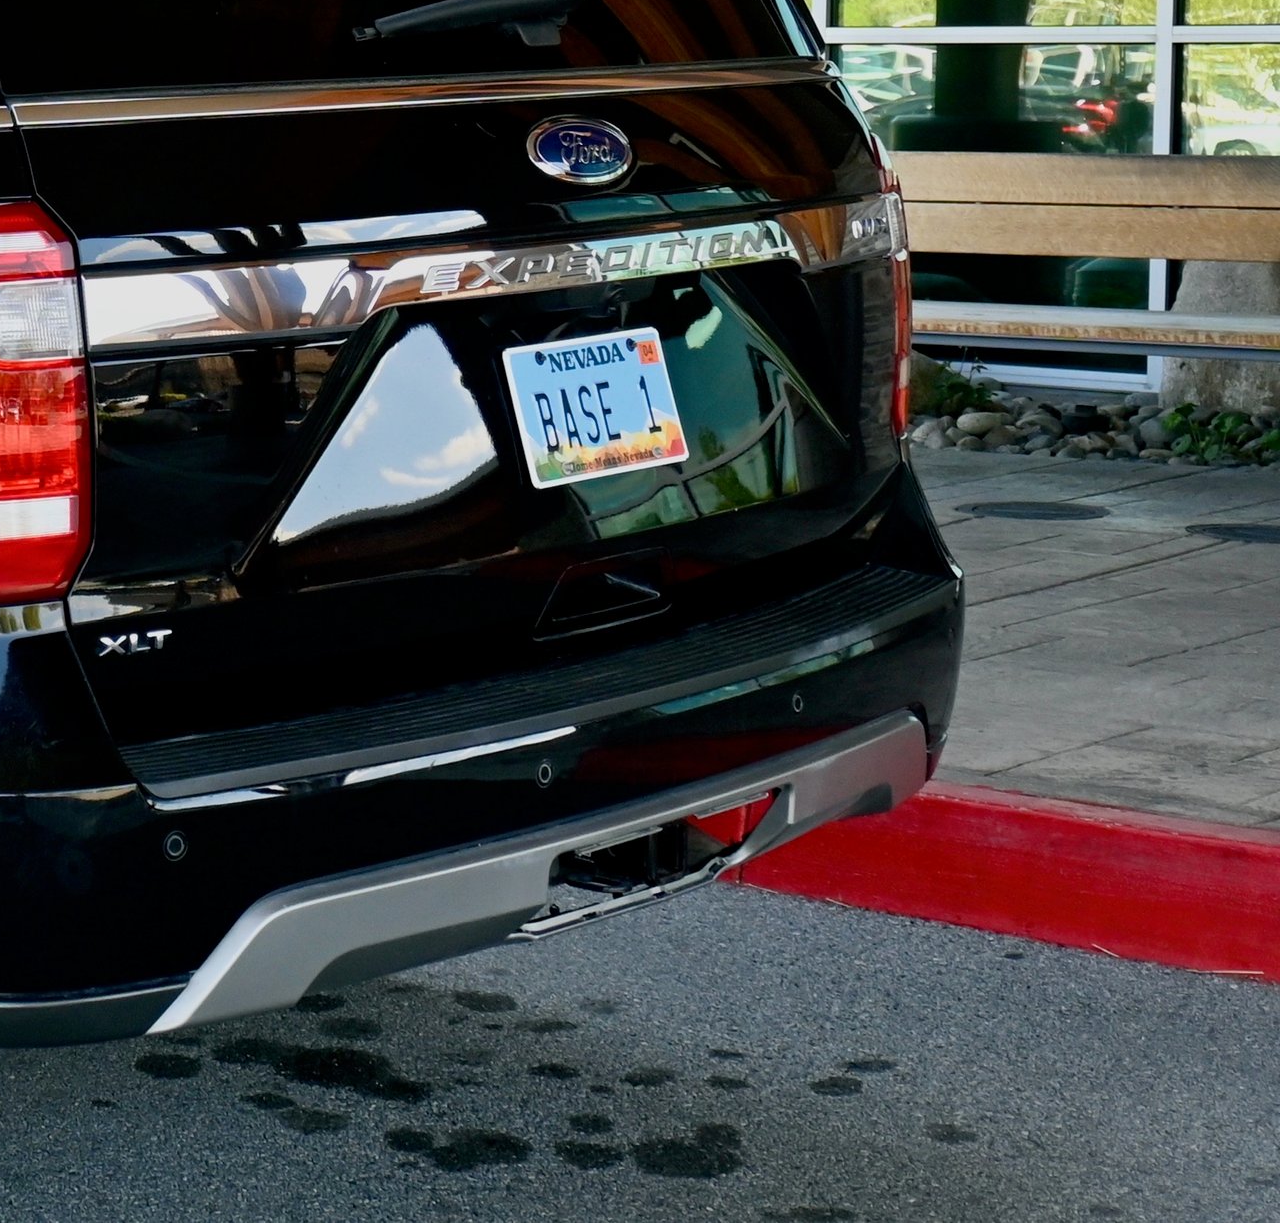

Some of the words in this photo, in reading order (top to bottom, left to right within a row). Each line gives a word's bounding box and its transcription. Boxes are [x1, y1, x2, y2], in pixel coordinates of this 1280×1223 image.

[558, 130, 616, 166] Ford
[419, 225, 767, 294] EXPEDITION
[547, 342, 626, 373] NEVADA
[533, 381, 622, 453] BASE
[639, 375, 663, 434] 1
[99, 629, 173, 656] XLT
